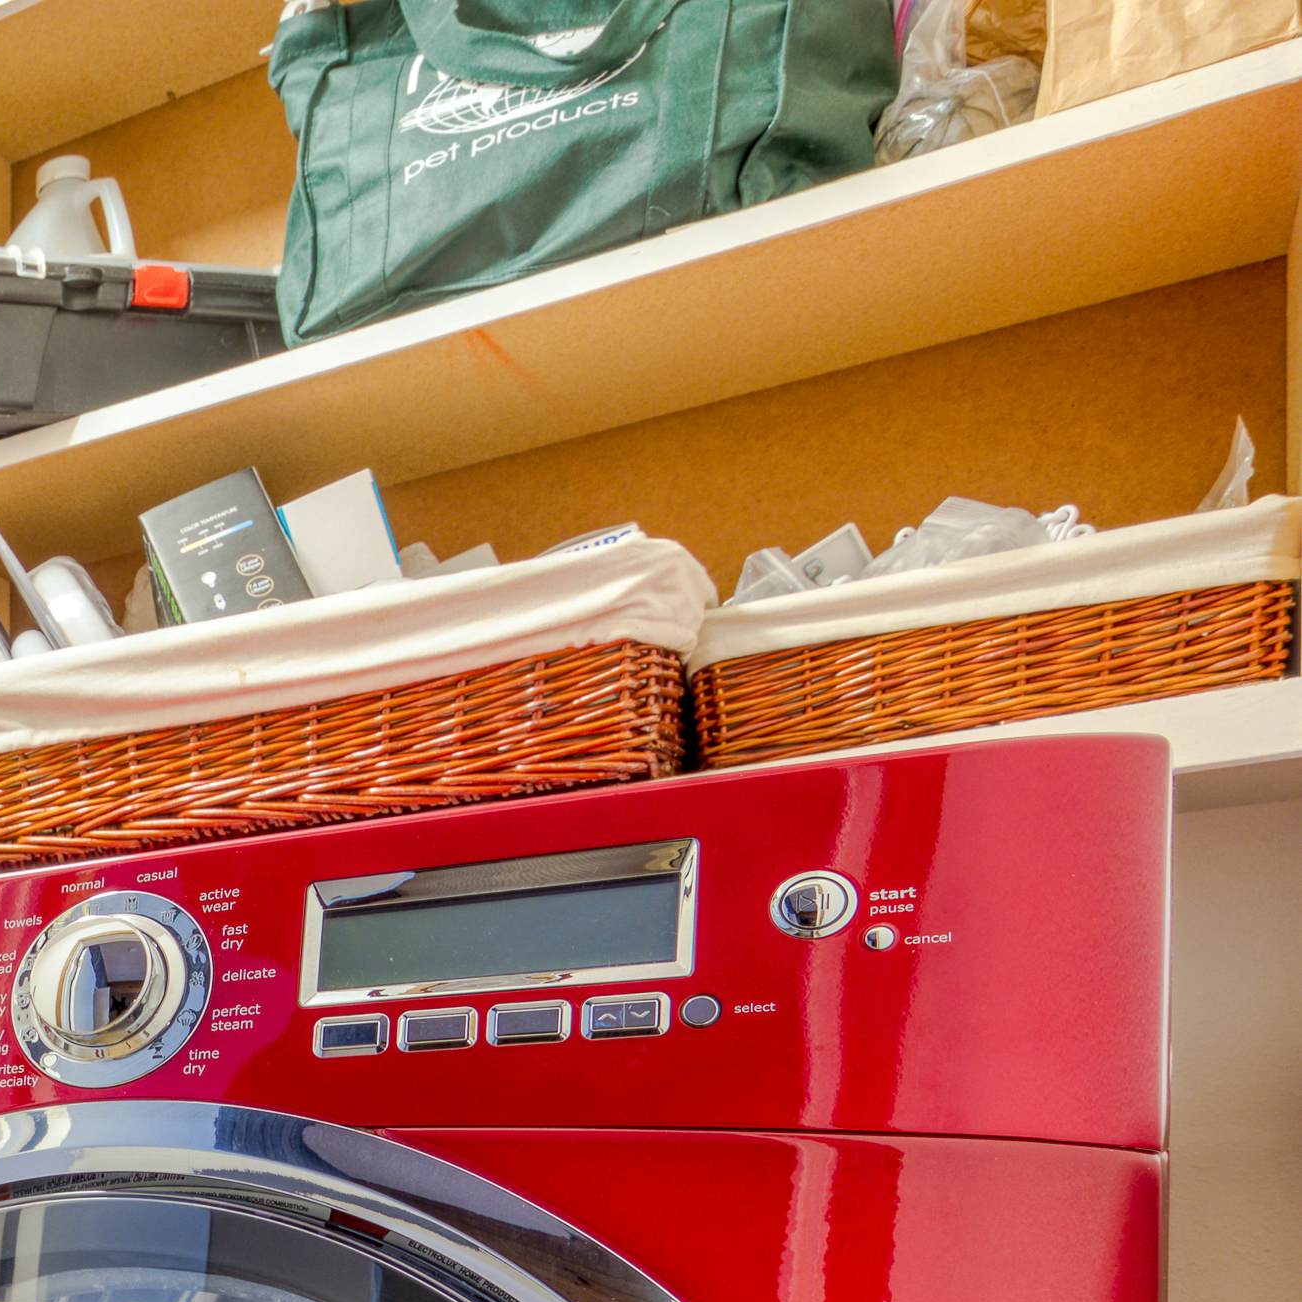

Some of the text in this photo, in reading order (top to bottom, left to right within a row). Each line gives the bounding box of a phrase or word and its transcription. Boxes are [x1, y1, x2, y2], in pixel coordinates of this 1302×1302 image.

[404, 91, 639, 184] pet products
[137, 867, 178, 883] casual
[62, 877, 105, 894] normal
[199, 888, 240, 901] active
[869, 886, 917, 901] start
[202, 901, 236, 913] wear
[869, 903, 914, 917] pause
[4, 914, 43, 929] towels
[222, 923, 249, 936] fast
[221, 938, 244, 951] dry
[904, 932, 952, 945] cancel
[222, 967, 277, 982] delicate
[212, 1004, 261, 1020] perfect
[733, 1002, 776, 1014] select
[211, 1019, 253, 1032] steam
[189, 1049, 220, 1060] time
[183, 1063, 206, 1076] dry
[265, 1199, 309, 1213] COMBUSTION
[408, 1240, 457, 1270] ELECTROLUX
[459, 1265, 482, 1283] HOME
